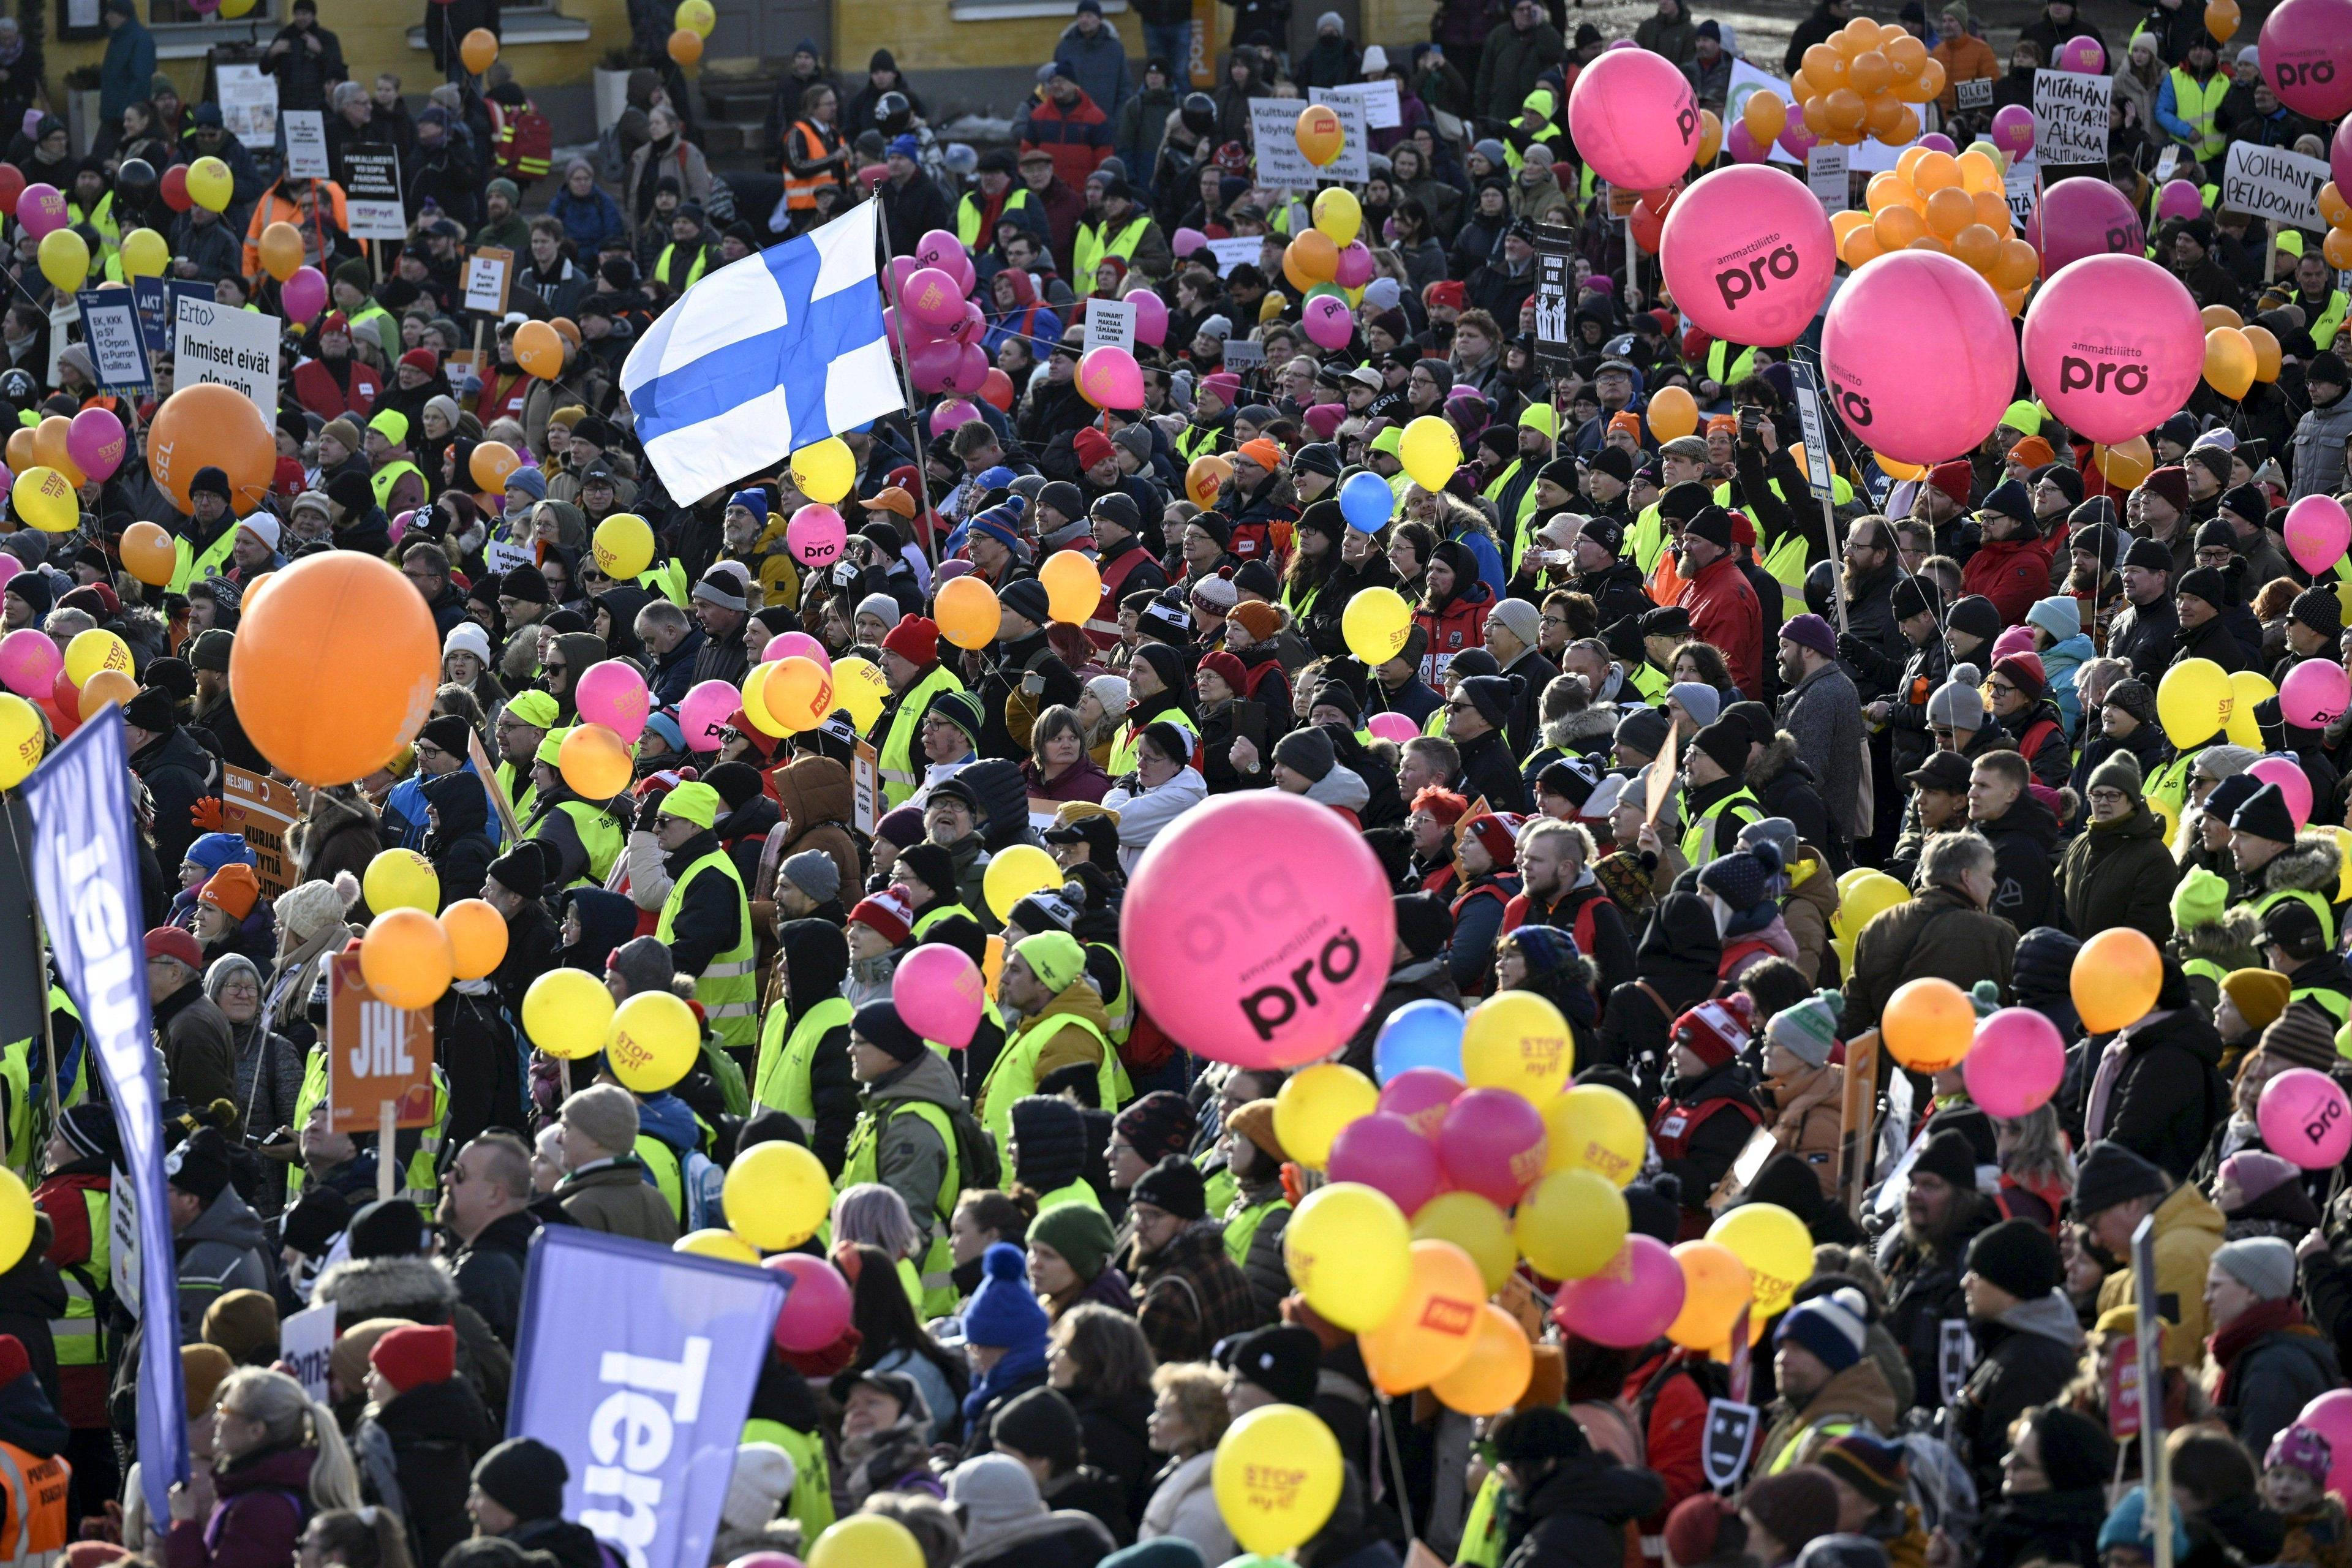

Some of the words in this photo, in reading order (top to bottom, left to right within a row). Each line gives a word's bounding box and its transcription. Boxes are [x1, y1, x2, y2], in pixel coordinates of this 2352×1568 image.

[2276, 60, 2335, 91] pro
[1961, 85, 1989, 100] OLEN
[2036, 75, 2108, 109] MITÄHÄN
[2035, 102, 2109, 130] VITTUA?!!
[2052, 121, 2105, 155] ALKAA
[2236, 148, 2311, 190] VOIHAN
[1260, 175, 1315, 187] lancereita!
[2226, 175, 2305, 221] PEIJOONI
[1717, 232, 1781, 266] ammattiliitto
[1715, 243, 1800, 311] pro
[920, 281, 938, 311] STOP
[1540, 282, 1552, 295] ORPO
[1552, 283, 1564, 296] OLLA
[143, 295, 164, 309] AKT
[92, 317, 105, 327] EK,
[105, 315, 123, 326] KKK
[1096, 311, 1123, 320] DUUNARIT
[1098, 318, 1121, 328] MAKSAA
[95, 327, 104, 339] ja
[104, 326, 115, 337] SY
[1095, 326, 1123, 336] TÄMÄNKIN
[1097, 334, 1120, 342] LASKUN
[104, 339, 130, 353] Orpon
[110, 349, 136, 361] Purran
[184, 334, 235, 369] Ihmiset
[236, 345, 270, 375] eivät
[2071, 341, 2143, 357] ammattiliitto
[103, 361, 132, 372] hallitus
[2060, 355, 2149, 396] pro
[97, 437, 124, 459] STOP
[1806, 434, 1811, 449] EI
[1811, 435, 1823, 451] SAA
[157, 441, 175, 483] SEL
[40, 470, 59, 496] STOP
[54, 478, 67, 499] nyt!
[1200, 477, 1218, 495] PAM
[417, 517, 428, 526] SEL
[594, 539, 618, 561] STOP
[804, 543, 835, 559] pro
[104, 641, 122, 671] STOP
[815, 687, 831, 712] PAM
[834, 726, 848, 735] PAM
[225, 773, 254, 794] HELSINKI
[859, 801, 870, 814] MARS!
[244, 824, 282, 853] KURJAA
[1238, 926, 1361, 1042] pro
[350, 1001, 414, 1079] JHL
[617, 1031, 654, 1062] STOP
[1521, 1038, 1564, 1057] STOP
[2304, 1099, 2341, 1145] pro
[1244, 1464, 1305, 1490] STOP
